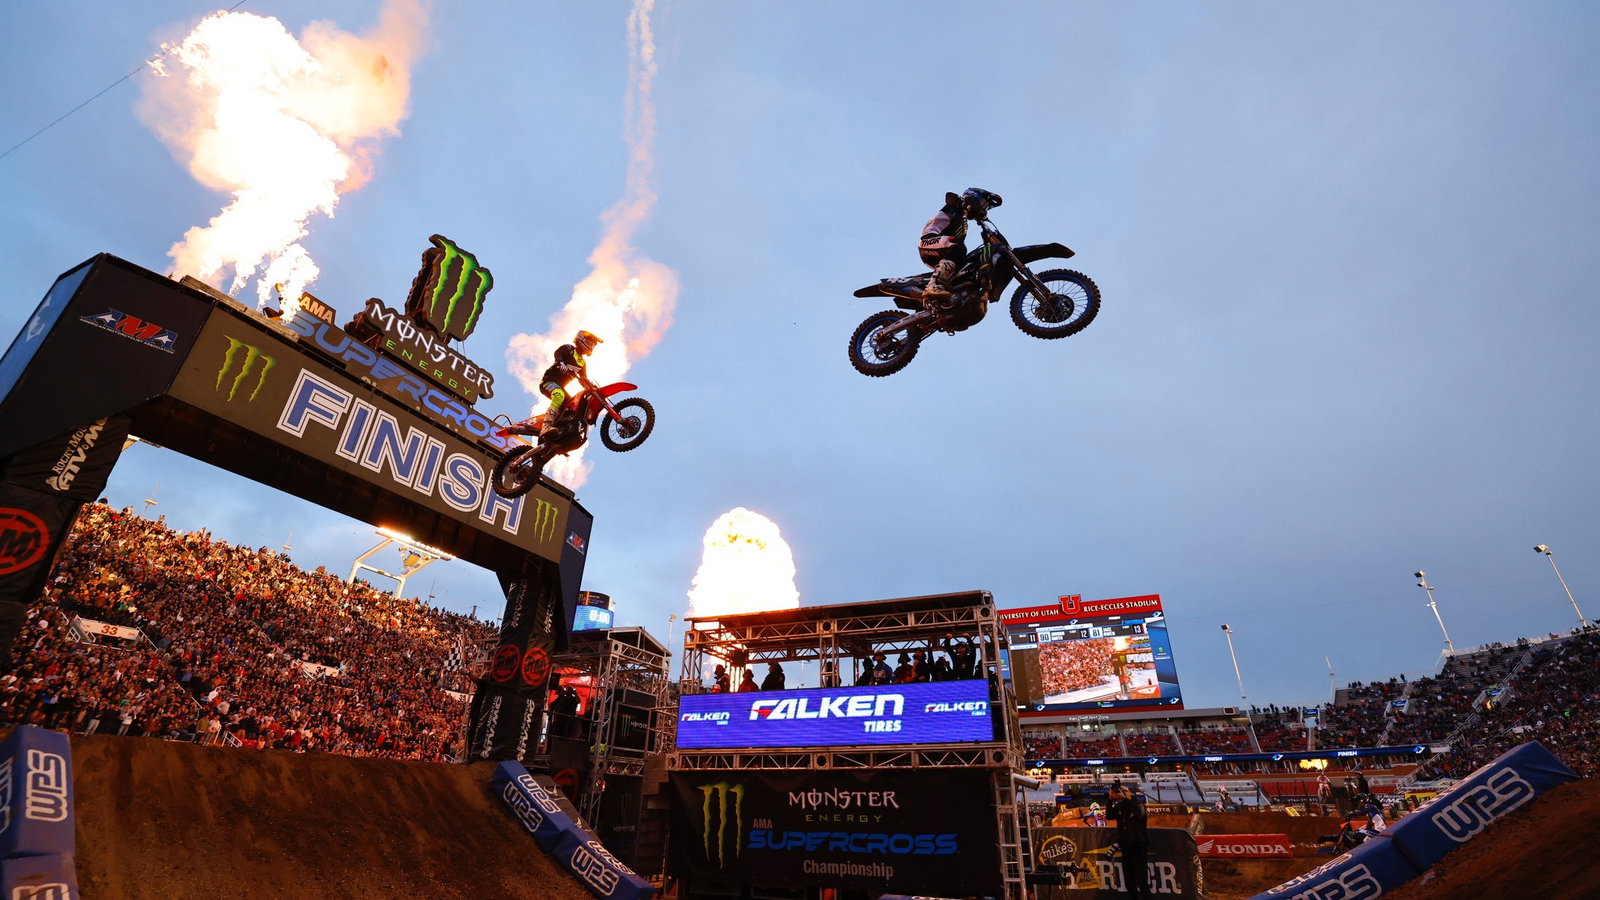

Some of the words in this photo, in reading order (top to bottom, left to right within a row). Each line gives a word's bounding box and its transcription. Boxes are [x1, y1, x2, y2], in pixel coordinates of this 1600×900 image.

[921, 237, 941, 246] THOR
[300, 296, 333, 324] AMA
[371, 303, 492, 394] MONSTER
[386, 340, 472, 396] ENERGY
[52, 446, 75, 474] ROCKY
[276, 367, 525, 536] FINISH
[1041, 609, 1059, 617] UTAH
[1058, 594, 1081, 615] U
[1083, 602, 1124, 613] RICE-ECCLES
[1126, 599, 1158, 609] STADIUM
[101, 625, 118, 635] 33
[1081, 630, 1088, 638] 12
[681, 711, 730, 722] FALKEN
[749, 694, 905, 721] FALKEN
[925, 701, 987, 713] FALKEN
[864, 720, 902, 733] TIRES
[25, 749, 68, 822] WPS
[517, 773, 561, 814] WPS
[503, 781, 544, 833] WPS
[789, 788, 900, 810] MONSTER
[1431, 766, 1535, 843] WPS
[753, 818, 773, 830] AMA
[805, 813, 882, 823] ENERGY
[747, 830, 959, 855] SUPERCROSS
[1042, 842, 1074, 861] mike's
[1216, 843, 1289, 855] HONDA
[571, 845, 620, 897] WPS
[803, 859, 894, 880] Championship
